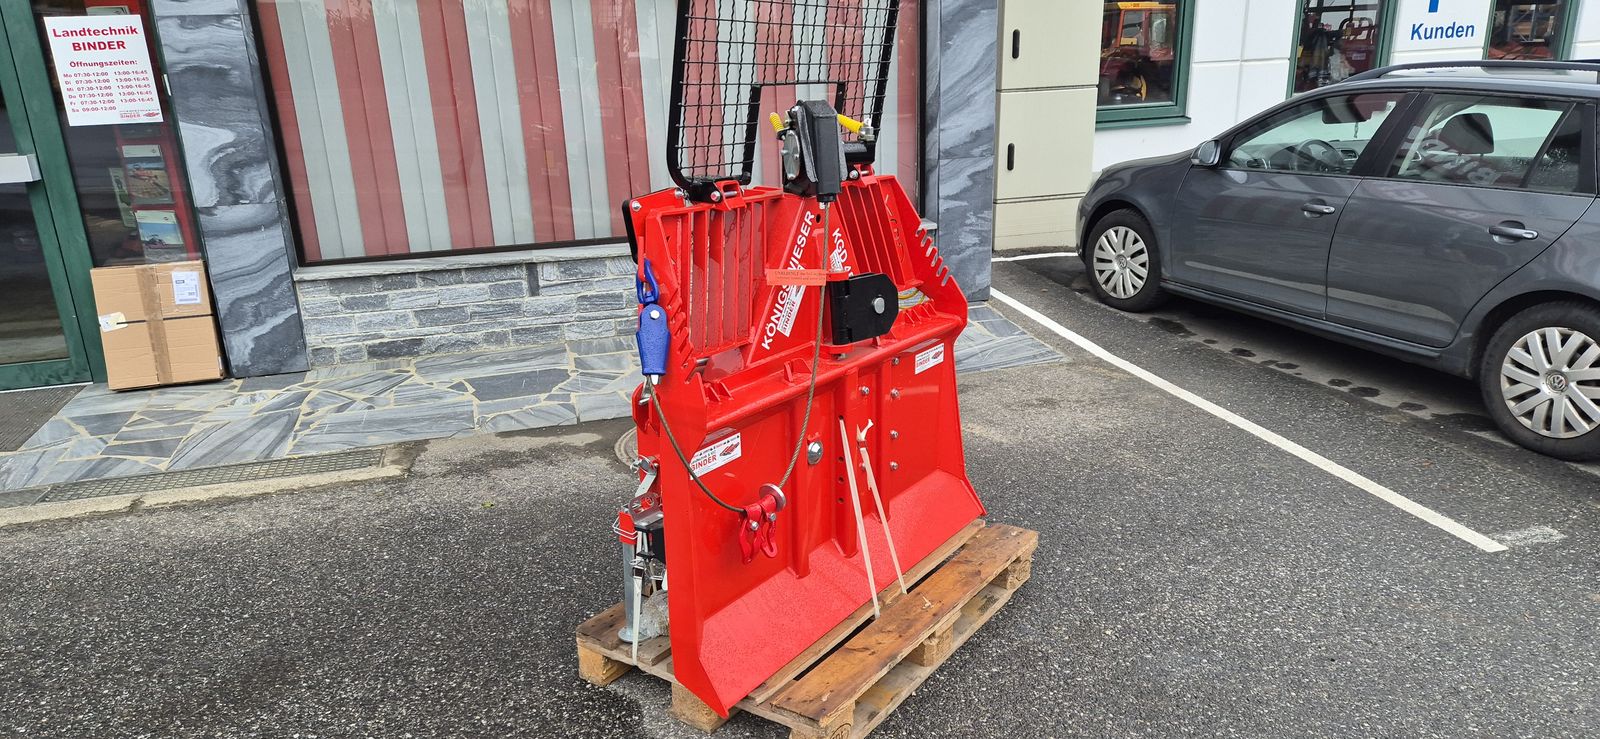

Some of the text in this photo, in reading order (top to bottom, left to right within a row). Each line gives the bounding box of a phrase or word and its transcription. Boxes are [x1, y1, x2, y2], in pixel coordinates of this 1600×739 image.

[52, 26, 138, 37] Landtechnik
[1411, 21, 1475, 40] Kunden
[72, 41, 126, 51] BINDER
[832, 227, 848, 263] KGD
